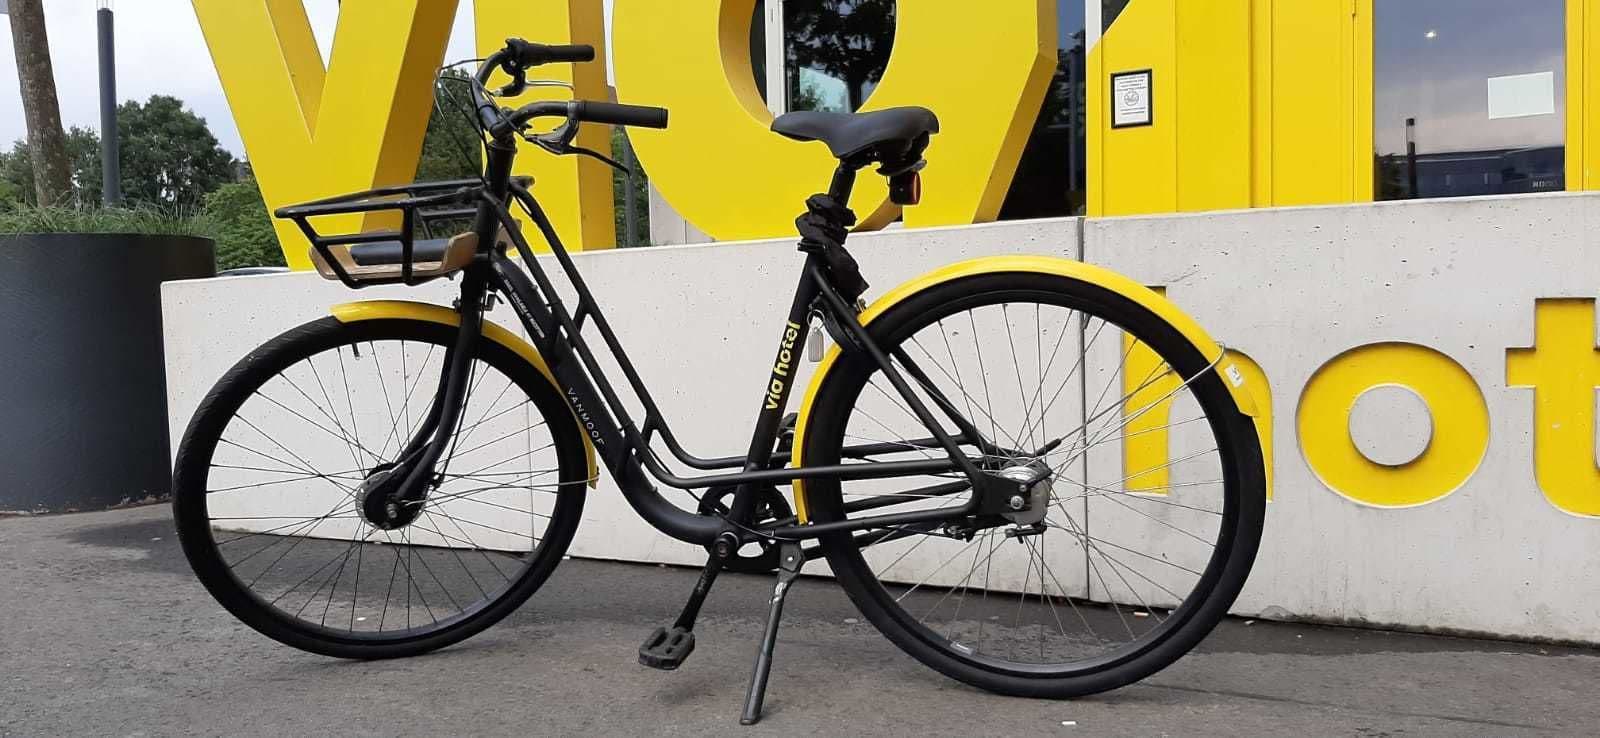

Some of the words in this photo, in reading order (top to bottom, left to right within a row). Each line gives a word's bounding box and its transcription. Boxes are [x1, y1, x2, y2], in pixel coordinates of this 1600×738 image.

[774, 321, 800, 376] hotel
[568, 387, 605, 445] VANMOOF
[766, 379, 784, 409] via
